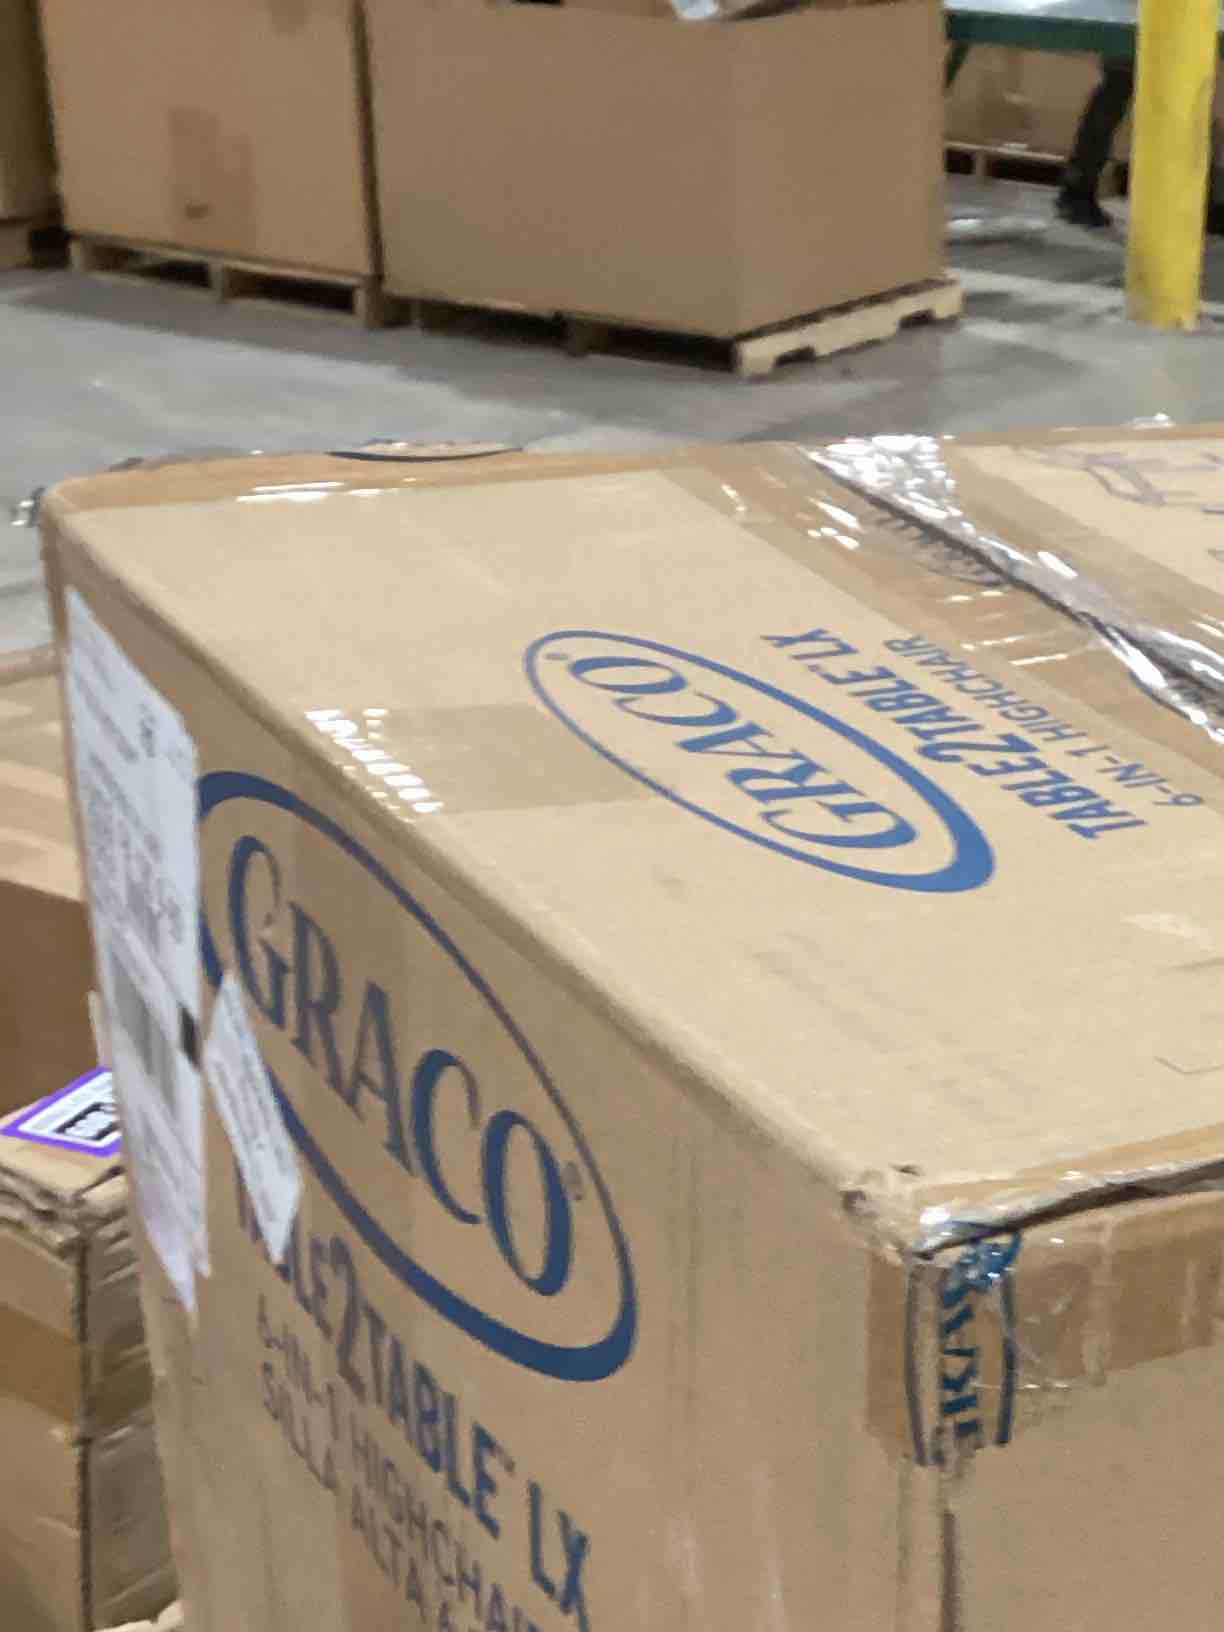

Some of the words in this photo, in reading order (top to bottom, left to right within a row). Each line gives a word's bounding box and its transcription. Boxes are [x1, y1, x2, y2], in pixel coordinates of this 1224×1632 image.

[762, 627, 859, 660] LX
[883, 634, 1088, 743] HIGHCHAIR
[1066, 743, 1204, 808] 6-IN-1
[352, 1484, 428, 1624] ALTA
